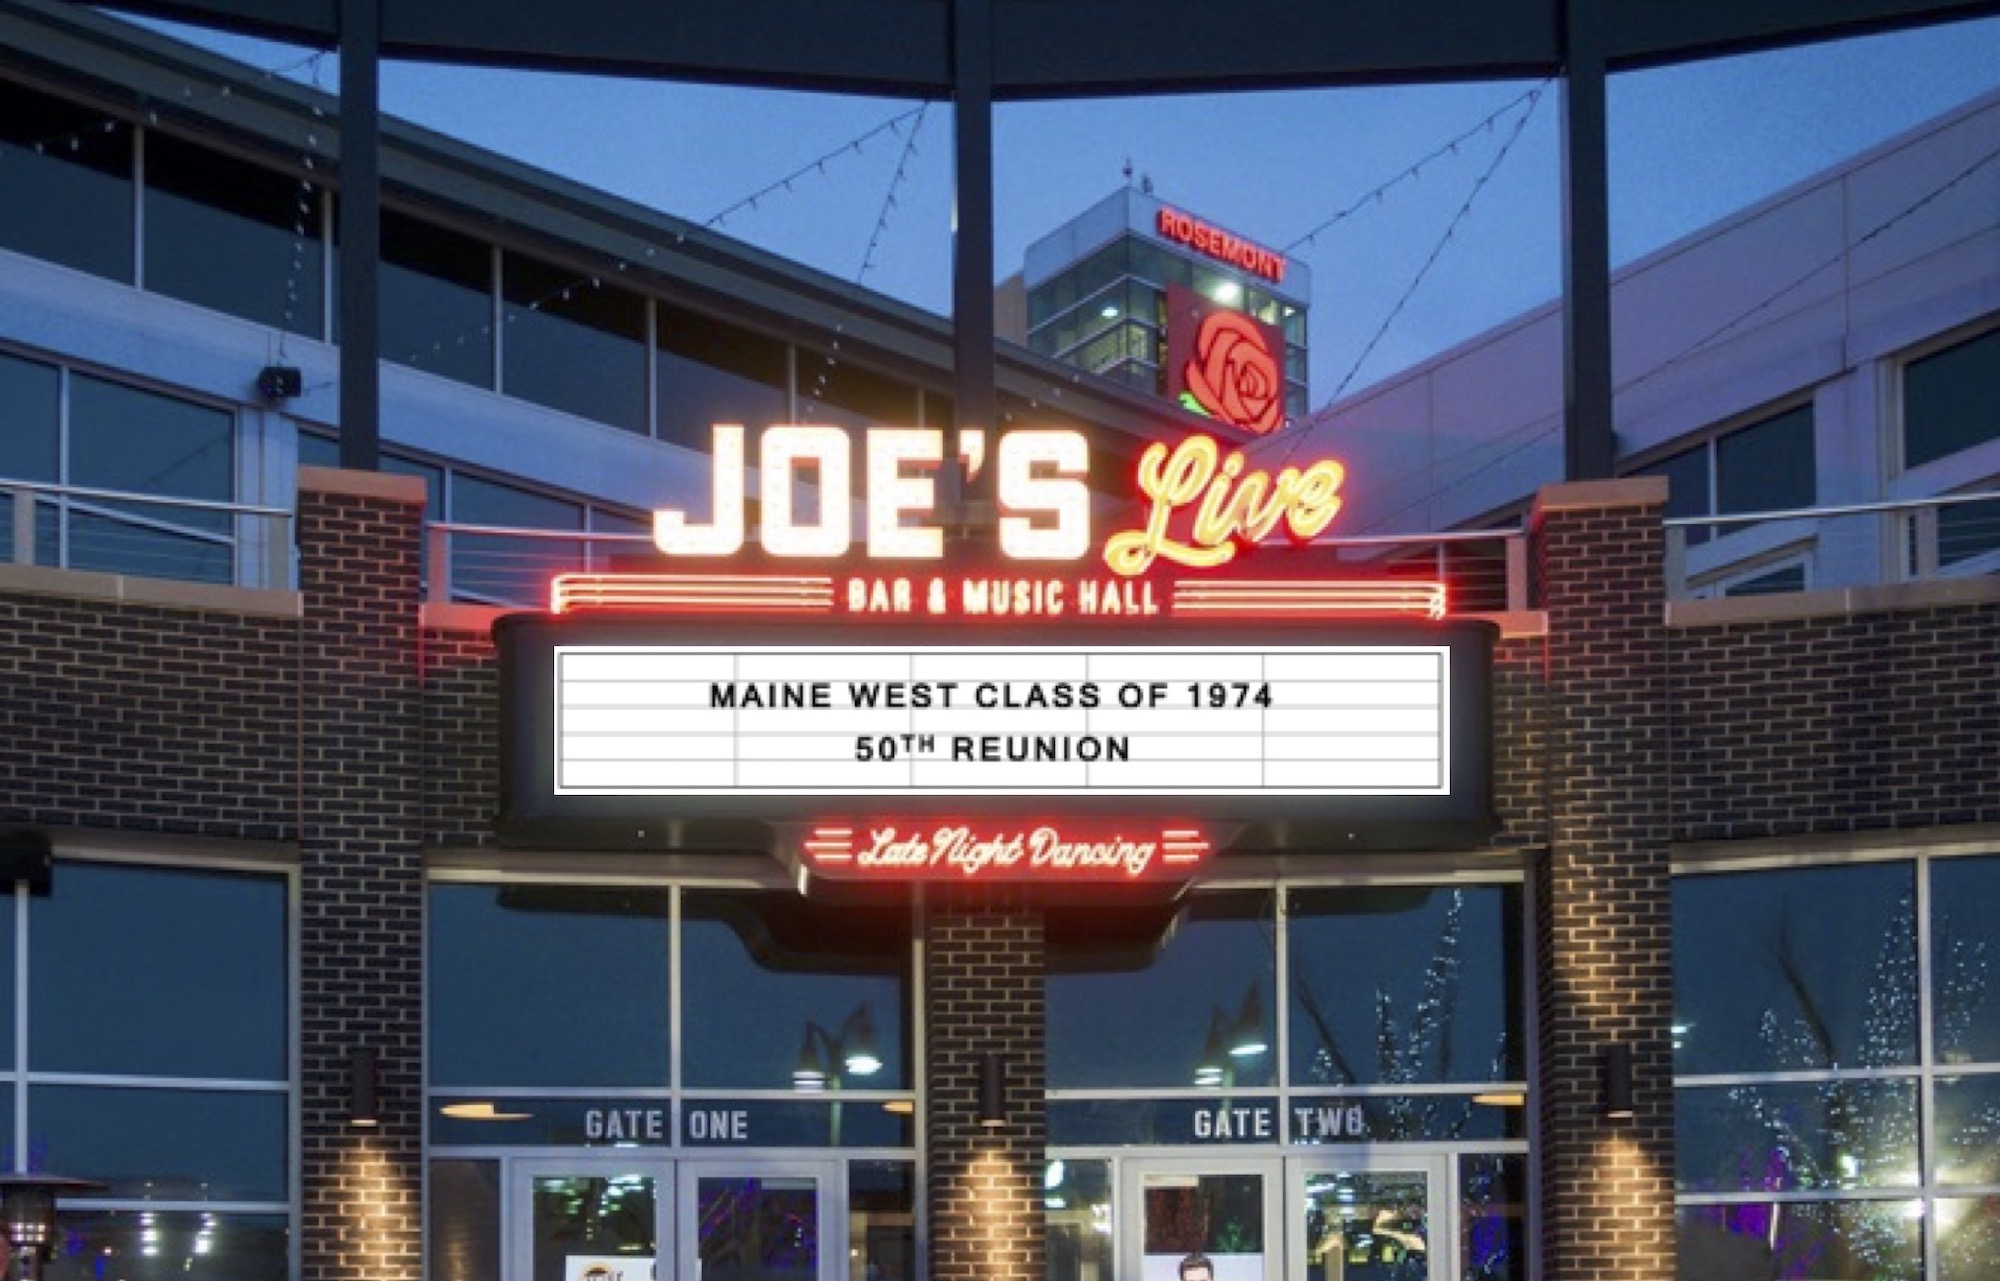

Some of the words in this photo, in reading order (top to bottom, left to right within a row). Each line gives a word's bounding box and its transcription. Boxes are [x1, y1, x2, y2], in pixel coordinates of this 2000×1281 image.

[1157, 203, 1287, 283] ROSEMONT
[652, 423, 1091, 561] JOE'S
[1104, 434, 1346, 577] Live
[848, 577, 911, 613] BAR
[927, 577, 946, 615] &
[963, 577, 1064, 615] MUSIC
[1078, 578, 1159, 616] HALL
[709, 682, 831, 709] MAINE
[848, 682, 958, 709] WEST
[974, 681, 1101, 709] CLASS
[1117, 681, 1168, 709] OF
[1187, 682, 1274, 709] 1974
[854, 734, 935, 763] 50TH
[952, 735, 1130, 763] REUNION
[857, 826, 929, 866] Late
[929, 826, 1024, 875] Night
[1028, 826, 1157, 876] Dancing
[585, 1109, 664, 1139] GATE
[689, 1110, 748, 1139] ONE
[1194, 1109, 1272, 1138] GATE
[1294, 1106, 1363, 1137] TWO
